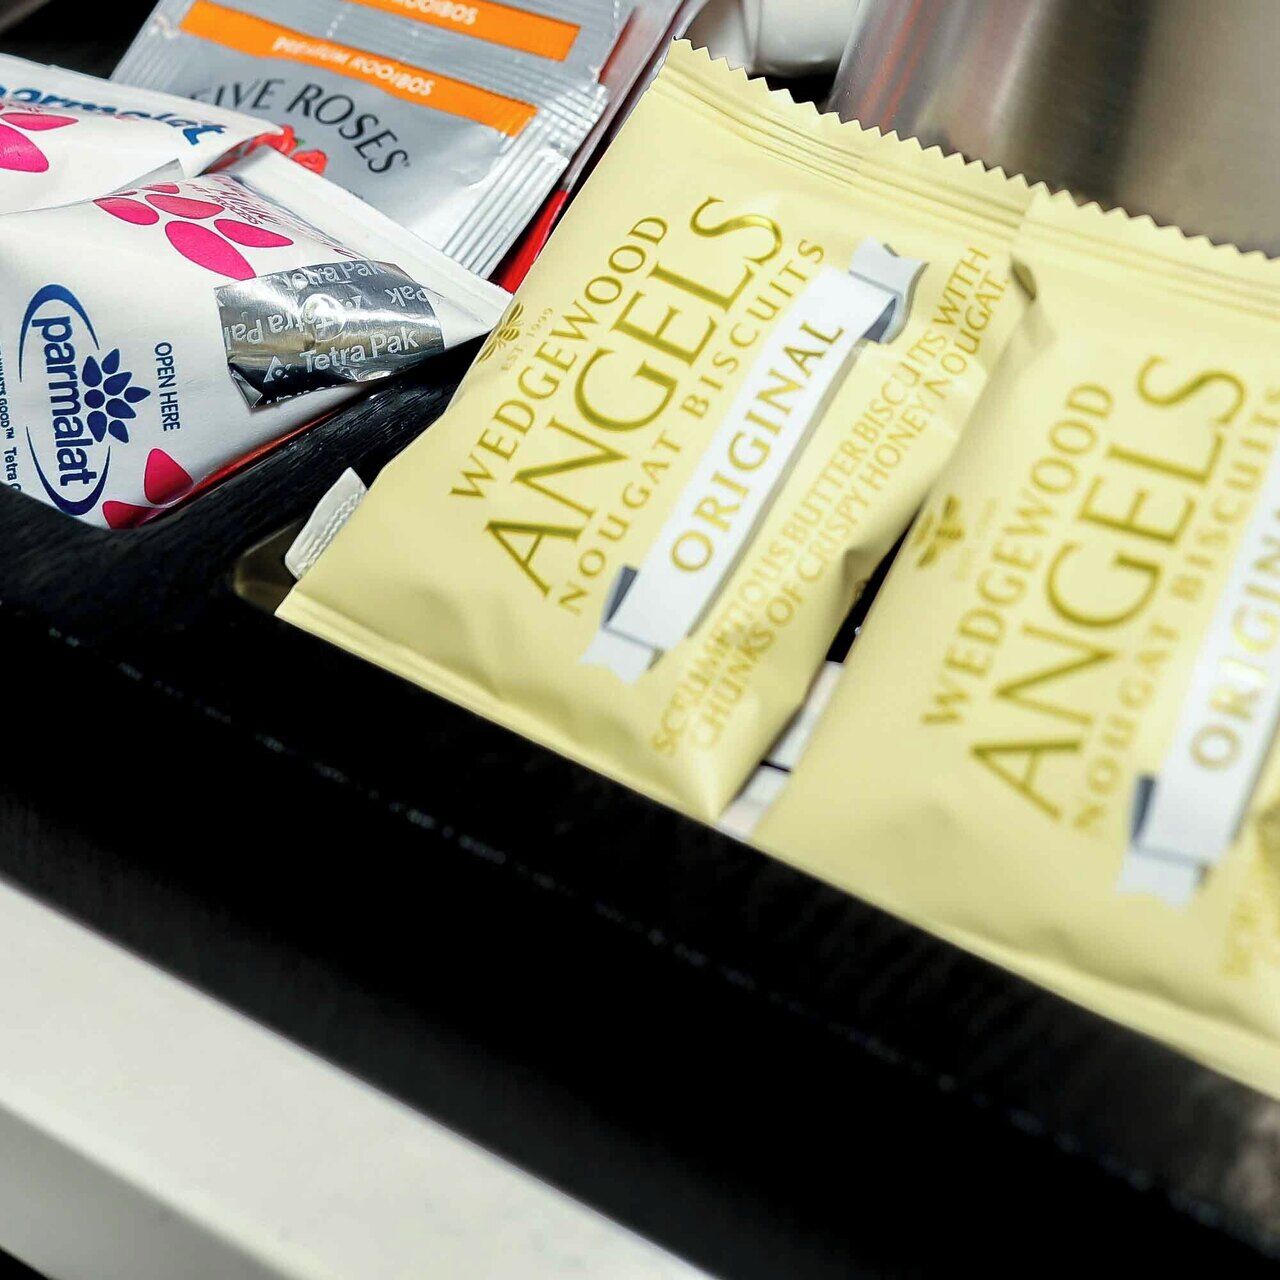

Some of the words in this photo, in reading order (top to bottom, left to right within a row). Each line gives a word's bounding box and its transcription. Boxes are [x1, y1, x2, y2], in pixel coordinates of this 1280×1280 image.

[272, 36, 351, 66] PREMIUM
[349, 56, 435, 96] ROOIBOS
[286, 83, 410, 174] ROSES
[31, 315, 98, 487] parmalat
[154, 342, 177, 389] OPEN
[161, 389, 181, 432] HERE
[300, 345, 366, 373] Tetra
[370, 327, 419, 356] Pak
[449, 215, 669, 500] WEDGEWOOD
[483, 196, 784, 598] ANGELS
[557, 429, 683, 616] NOUGAT
[679, 238, 825, 420] BISCUITS
[671, 321, 844, 574] ORIGINAL
[785, 433, 869, 546] BUTTER
[853, 328, 944, 452] BISCUITS
[932, 247, 991, 330] WITH
[691, 629, 775, 748] CHUNKS
[767, 582, 806, 628] OF
[796, 498, 870, 584] CRISPY
[857, 401, 936, 498] HONEY
[920, 380, 1114, 726] WEDGEWOOD
[969, 354, 1247, 824] ANGELS
[1072, 622, 1179, 832] NOUGAT
